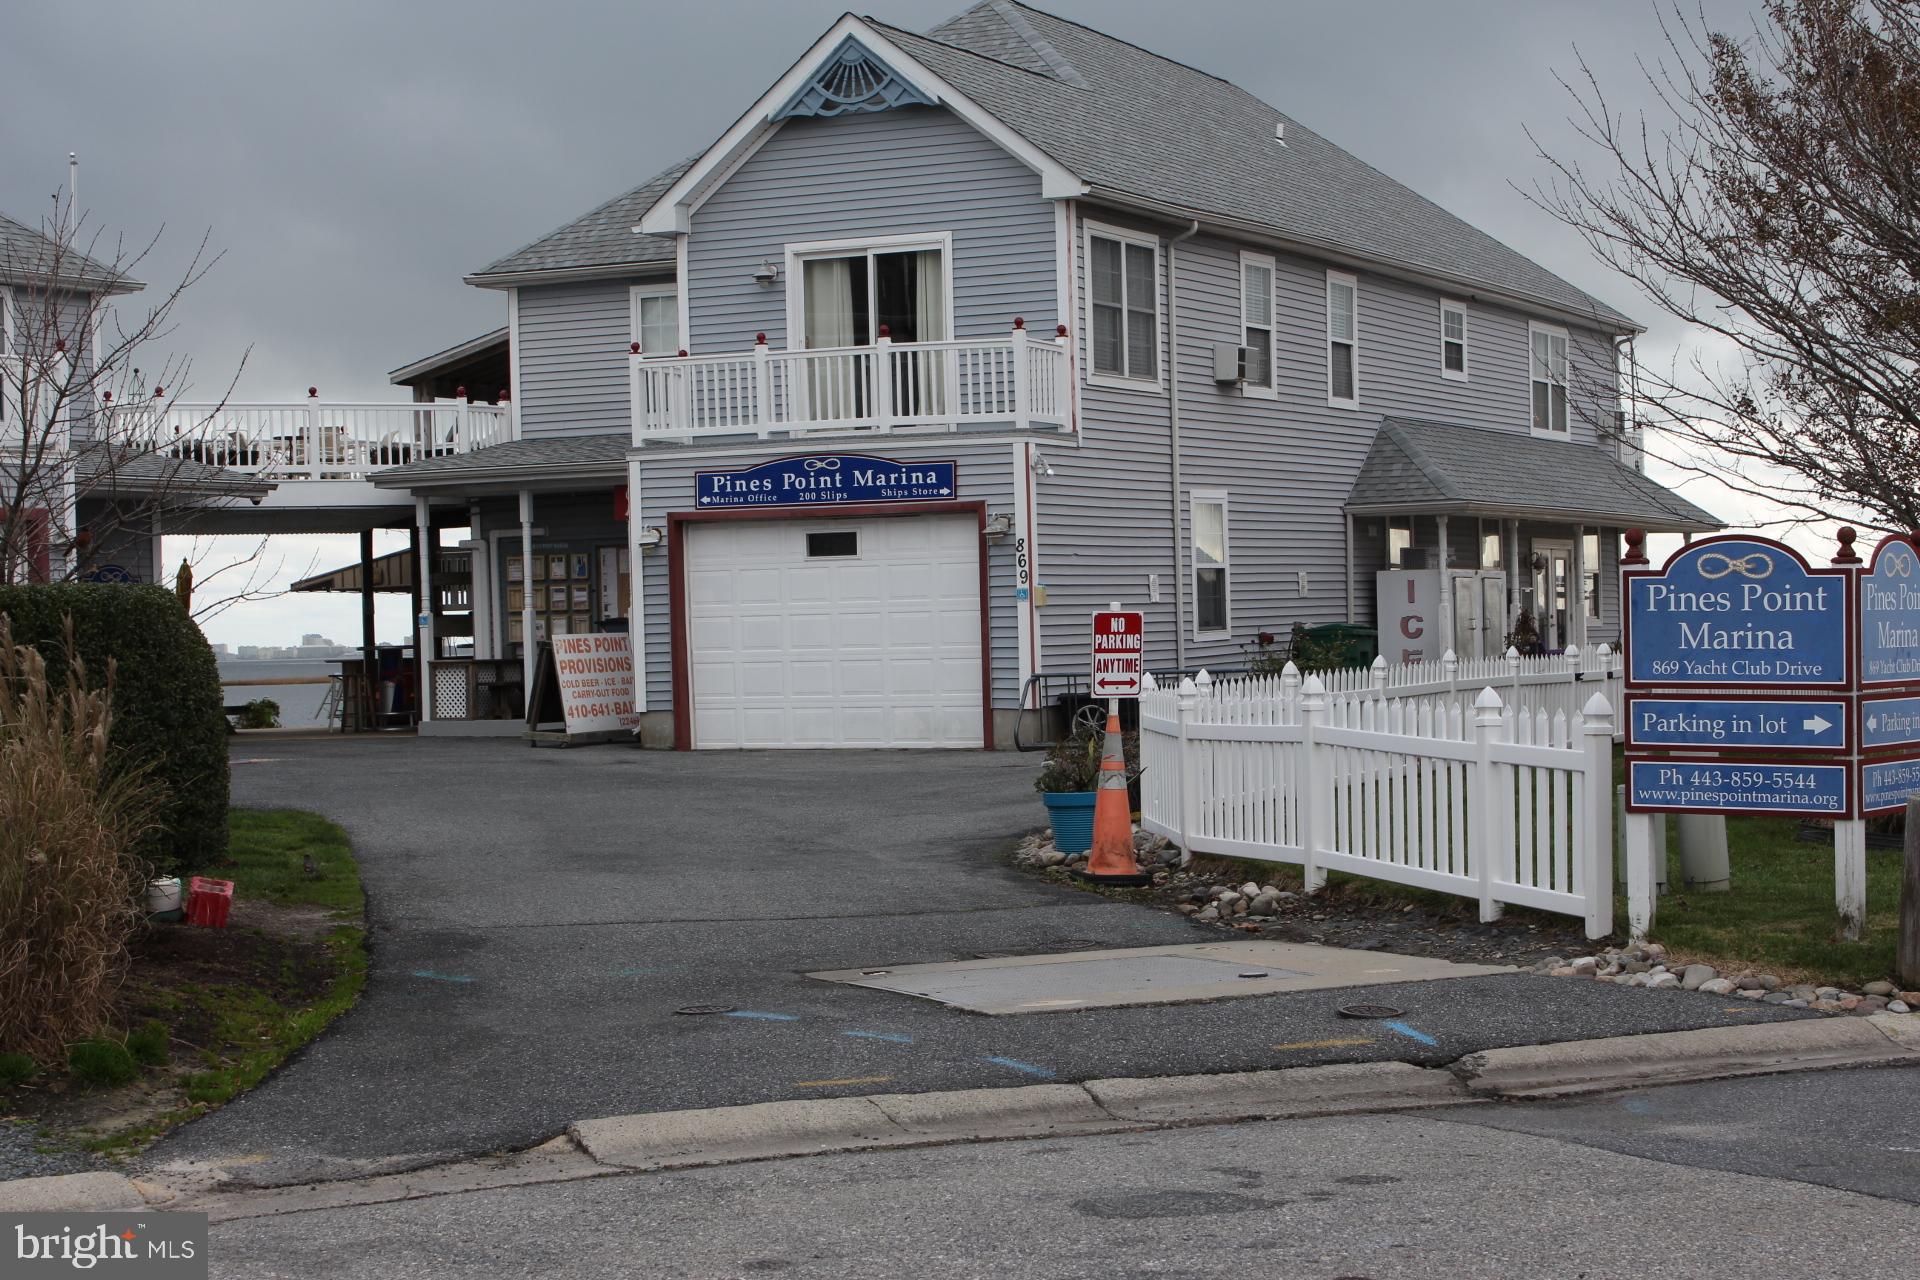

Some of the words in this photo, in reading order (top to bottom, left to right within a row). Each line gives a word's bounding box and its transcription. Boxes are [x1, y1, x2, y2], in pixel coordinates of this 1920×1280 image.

[713, 476, 772, 492] Pines
[783, 472, 842, 489] Point
[853, 468, 937, 486] Marina
[711, 494, 744, 504] Marina
[748, 493, 777, 502] Office
[799, 492, 816, 500] 200
[820, 490, 848, 501] Slips
[881, 488, 908, 498] Ships
[912, 486, 938, 496] Store
[1016, 538, 1028, 584] 869
[1647, 584, 1731, 612] Pines
[1741, 584, 1827, 612] Point
[1866, 584, 1896, 611] Pines
[1111, 617, 1125, 633] NO
[1095, 634, 1141, 650] PARKING
[1678, 622, 1795, 650] Marina
[1878, 621, 1919, 648] Marina
[594, 636, 628, 653] POINT
[559, 656, 632, 675] PROVISIONS
[1096, 658, 1139, 673] ANYTIME
[1652, 660, 1679, 675] 869
[1682, 660, 1728, 676] Yacht
[1731, 660, 1771, 676] Club
[1776, 661, 1822, 676] Drive
[1880, 659, 1896, 674] Yacht
[1896, 658, 1911, 673] Club
[561, 679, 580, 689] COLD
[581, 678, 599, 688] BEER
[604, 677, 617, 687] ICE
[572, 688, 610, 699] CARRY-OUT
[611, 687, 630, 698] FOOD
[567, 700, 636, 719] 410-641-BAI
[1642, 713, 1725, 740] Parking
[1731, 714, 1753, 734] in
[1759, 714, 1788, 734] lot
[1881, 712, 1911, 737] Parking
[1658, 769, 1683, 786] Ph
[1690, 770, 1817, 789] 443-859-5544
[1872, 770, 1882, 788] Ph
[1639, 787, 1838, 810] www.pinespointmarina.org
